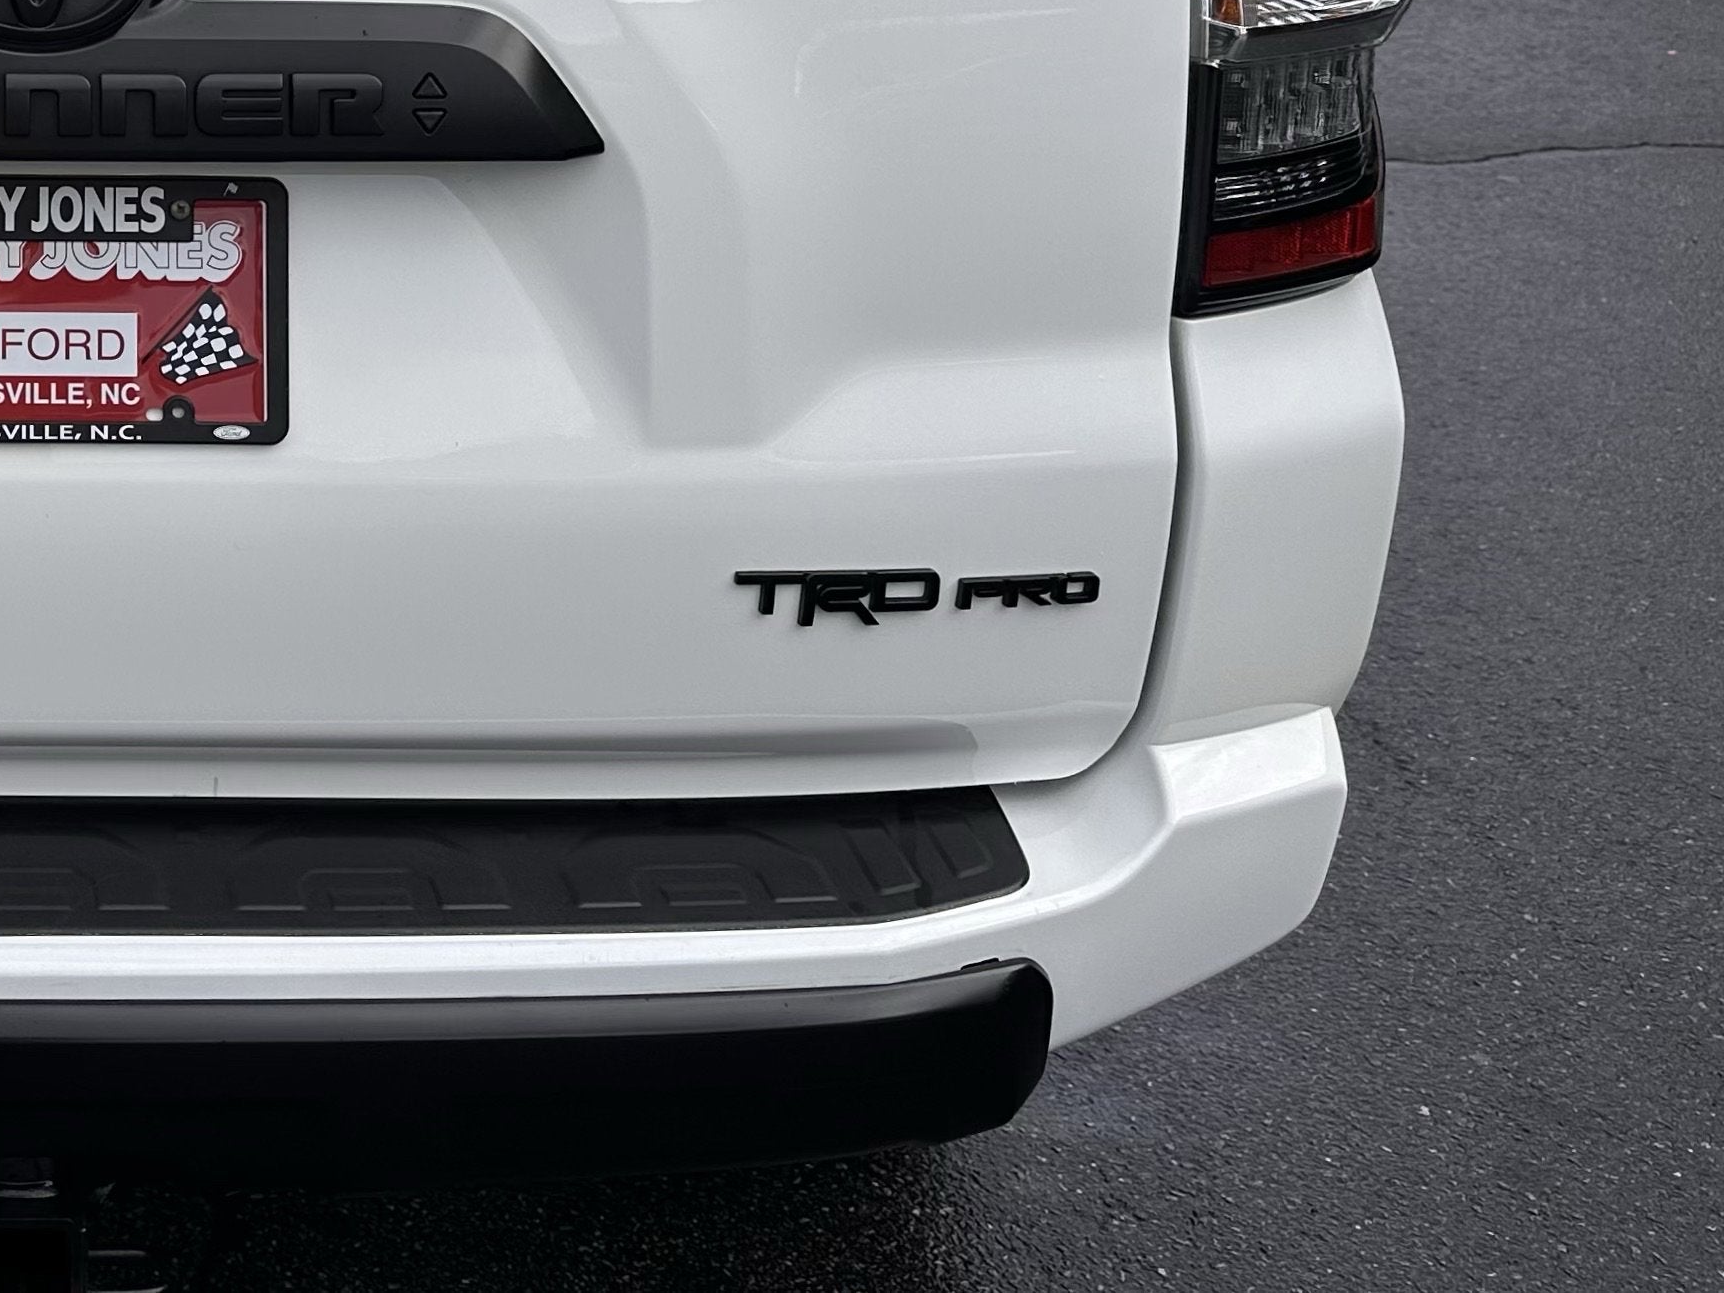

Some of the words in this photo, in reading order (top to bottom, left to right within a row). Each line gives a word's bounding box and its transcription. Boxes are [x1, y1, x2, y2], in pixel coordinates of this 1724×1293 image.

[30, 186, 166, 234] JONES
[28, 220, 244, 283] JONES
[1, 327, 125, 361] FORD
[100, 382, 141, 406] NC
[90, 424, 143, 441] N.C.
[733, 567, 941, 627] TRD
[954, 570, 1101, 611] PRO
